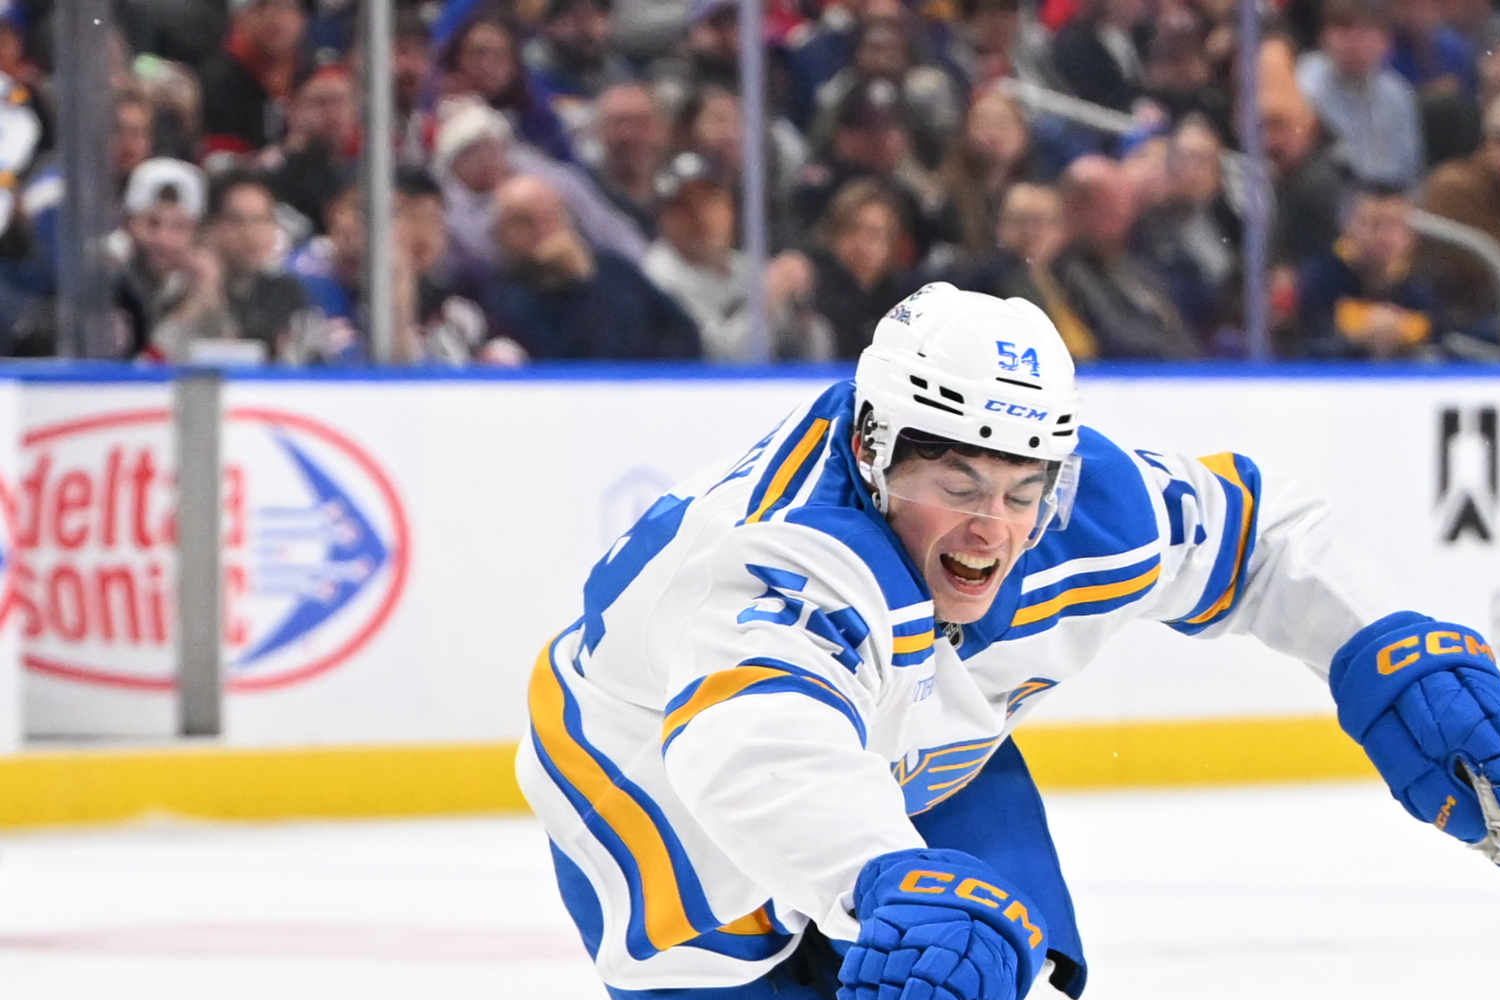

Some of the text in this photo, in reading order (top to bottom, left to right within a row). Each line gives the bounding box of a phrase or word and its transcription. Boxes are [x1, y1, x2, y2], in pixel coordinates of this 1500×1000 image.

[995, 340, 1041, 378] 54
[983, 399, 1049, 422] CCM
[1376, 630, 1496, 676] CCM
[898, 869, 1044, 949] CCM
